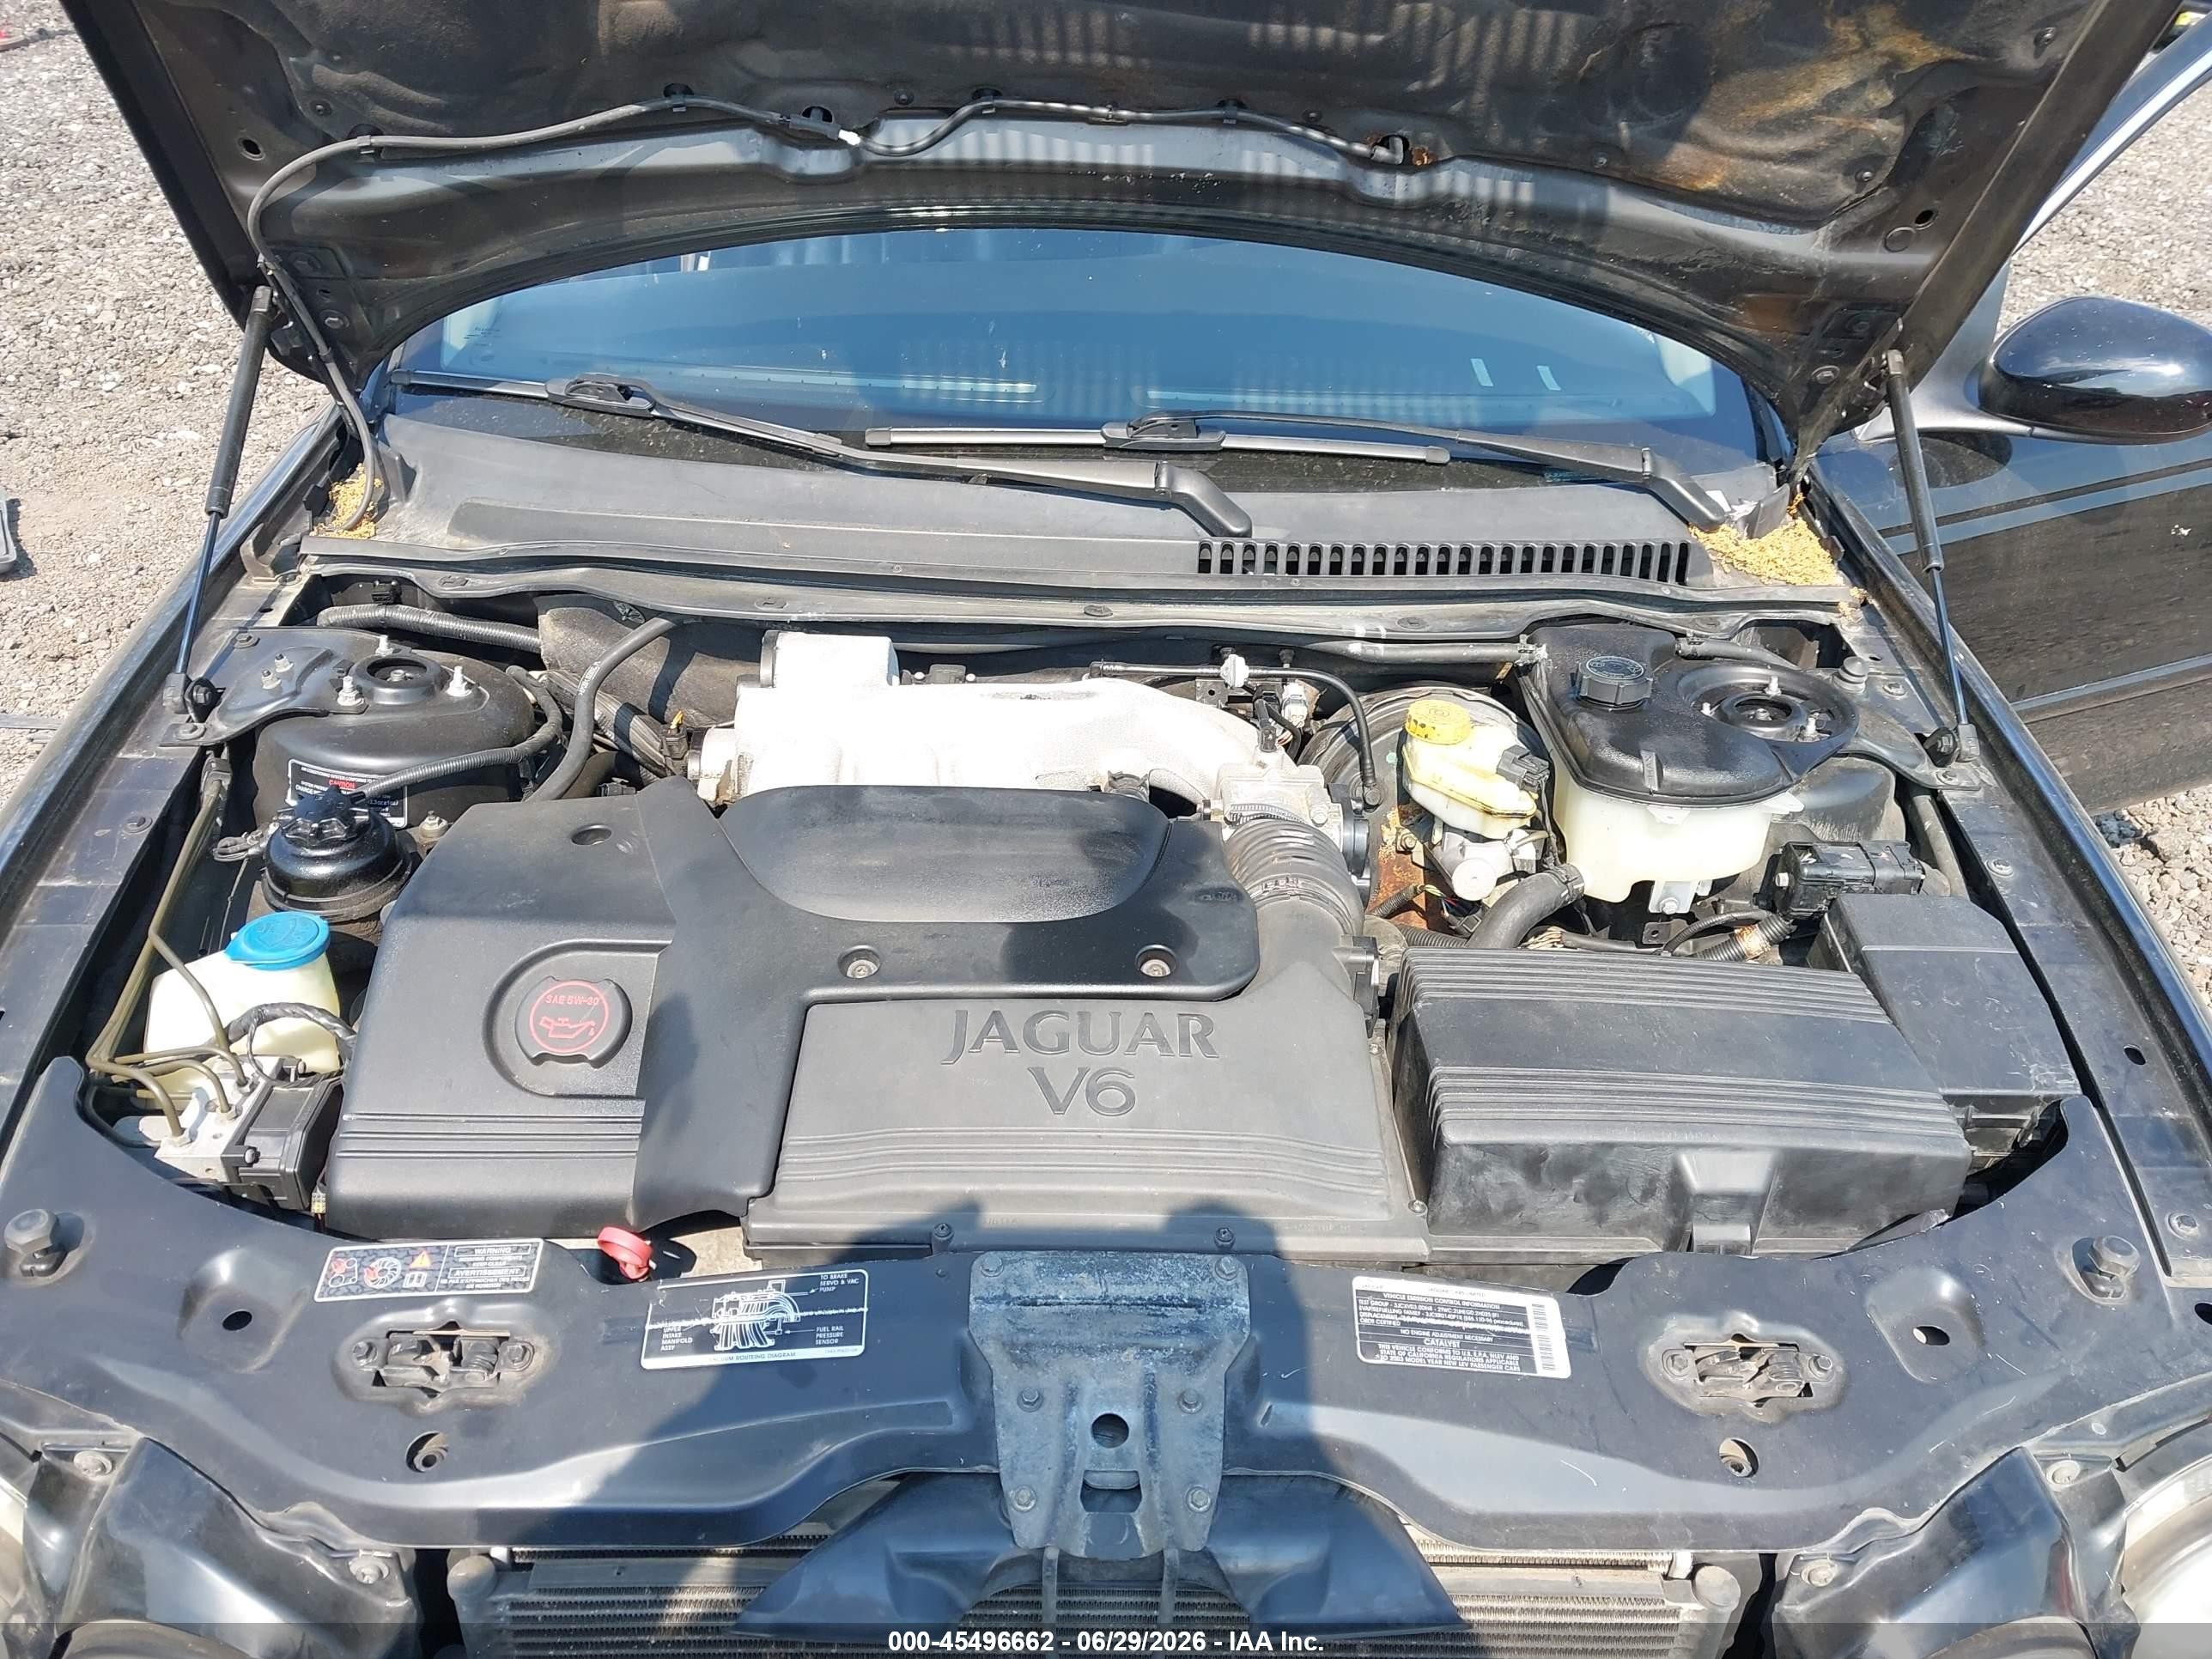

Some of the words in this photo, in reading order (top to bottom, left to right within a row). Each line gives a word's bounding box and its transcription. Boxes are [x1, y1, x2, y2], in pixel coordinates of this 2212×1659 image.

[568, 996, 599, 1006] 5W-30
[940, 1009, 1219, 1065] JAGUAR
[1028, 1066, 1136, 1117] V6
[454, 1267, 520, 1277] AVERTISSEMENT
[1434, 1297, 1462, 1306] CONTROL
[1462, 1301, 1500, 1310] INFORMATION
[1431, 1331, 1463, 1340] ADJUSTMENT
[1424, 1338, 1460, 1348] CATALYST
[1417, 1346, 1451, 1355] CONFORMS
[1443, 1354, 1485, 1363] REGULATIONS
[1485, 1358, 1519, 1366] APPLICABLE
